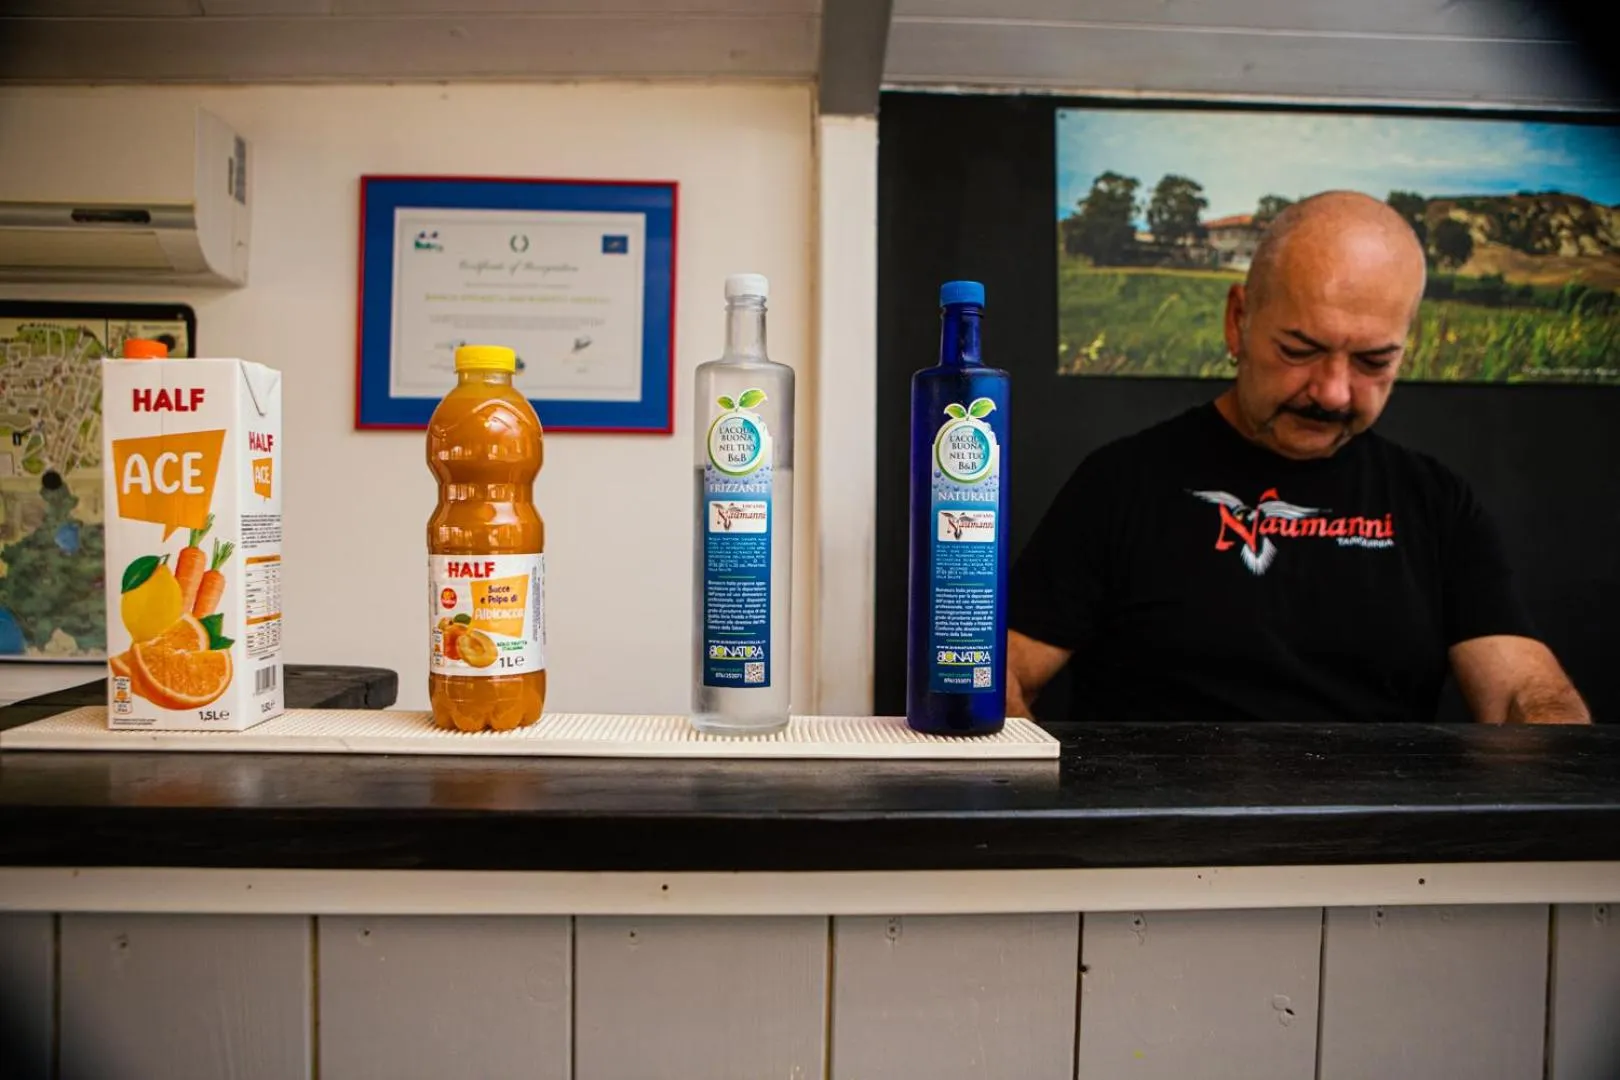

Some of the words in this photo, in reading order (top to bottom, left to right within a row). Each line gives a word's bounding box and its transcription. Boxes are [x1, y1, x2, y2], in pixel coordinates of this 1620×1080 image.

[132, 388, 206, 412] HALF
[248, 431, 274, 453] HALF
[721, 434, 753, 442] BUONA
[719, 444, 736, 452] NEL
[738, 444, 755, 452] TUO
[951, 442, 983, 450] BUONA
[728, 453, 747, 463] B&B
[949, 452, 966, 460] NEL
[968, 452, 985, 460] TUO
[958, 461, 977, 471] B&B
[122, 452, 206, 496] ACE
[254, 465, 271, 485] ACE
[709, 483, 768, 493] FRIZZANTE
[938, 491, 995, 501] NATURALE
[1214, 488, 1394, 554] Naumanni
[447, 561, 496, 578] HALF
